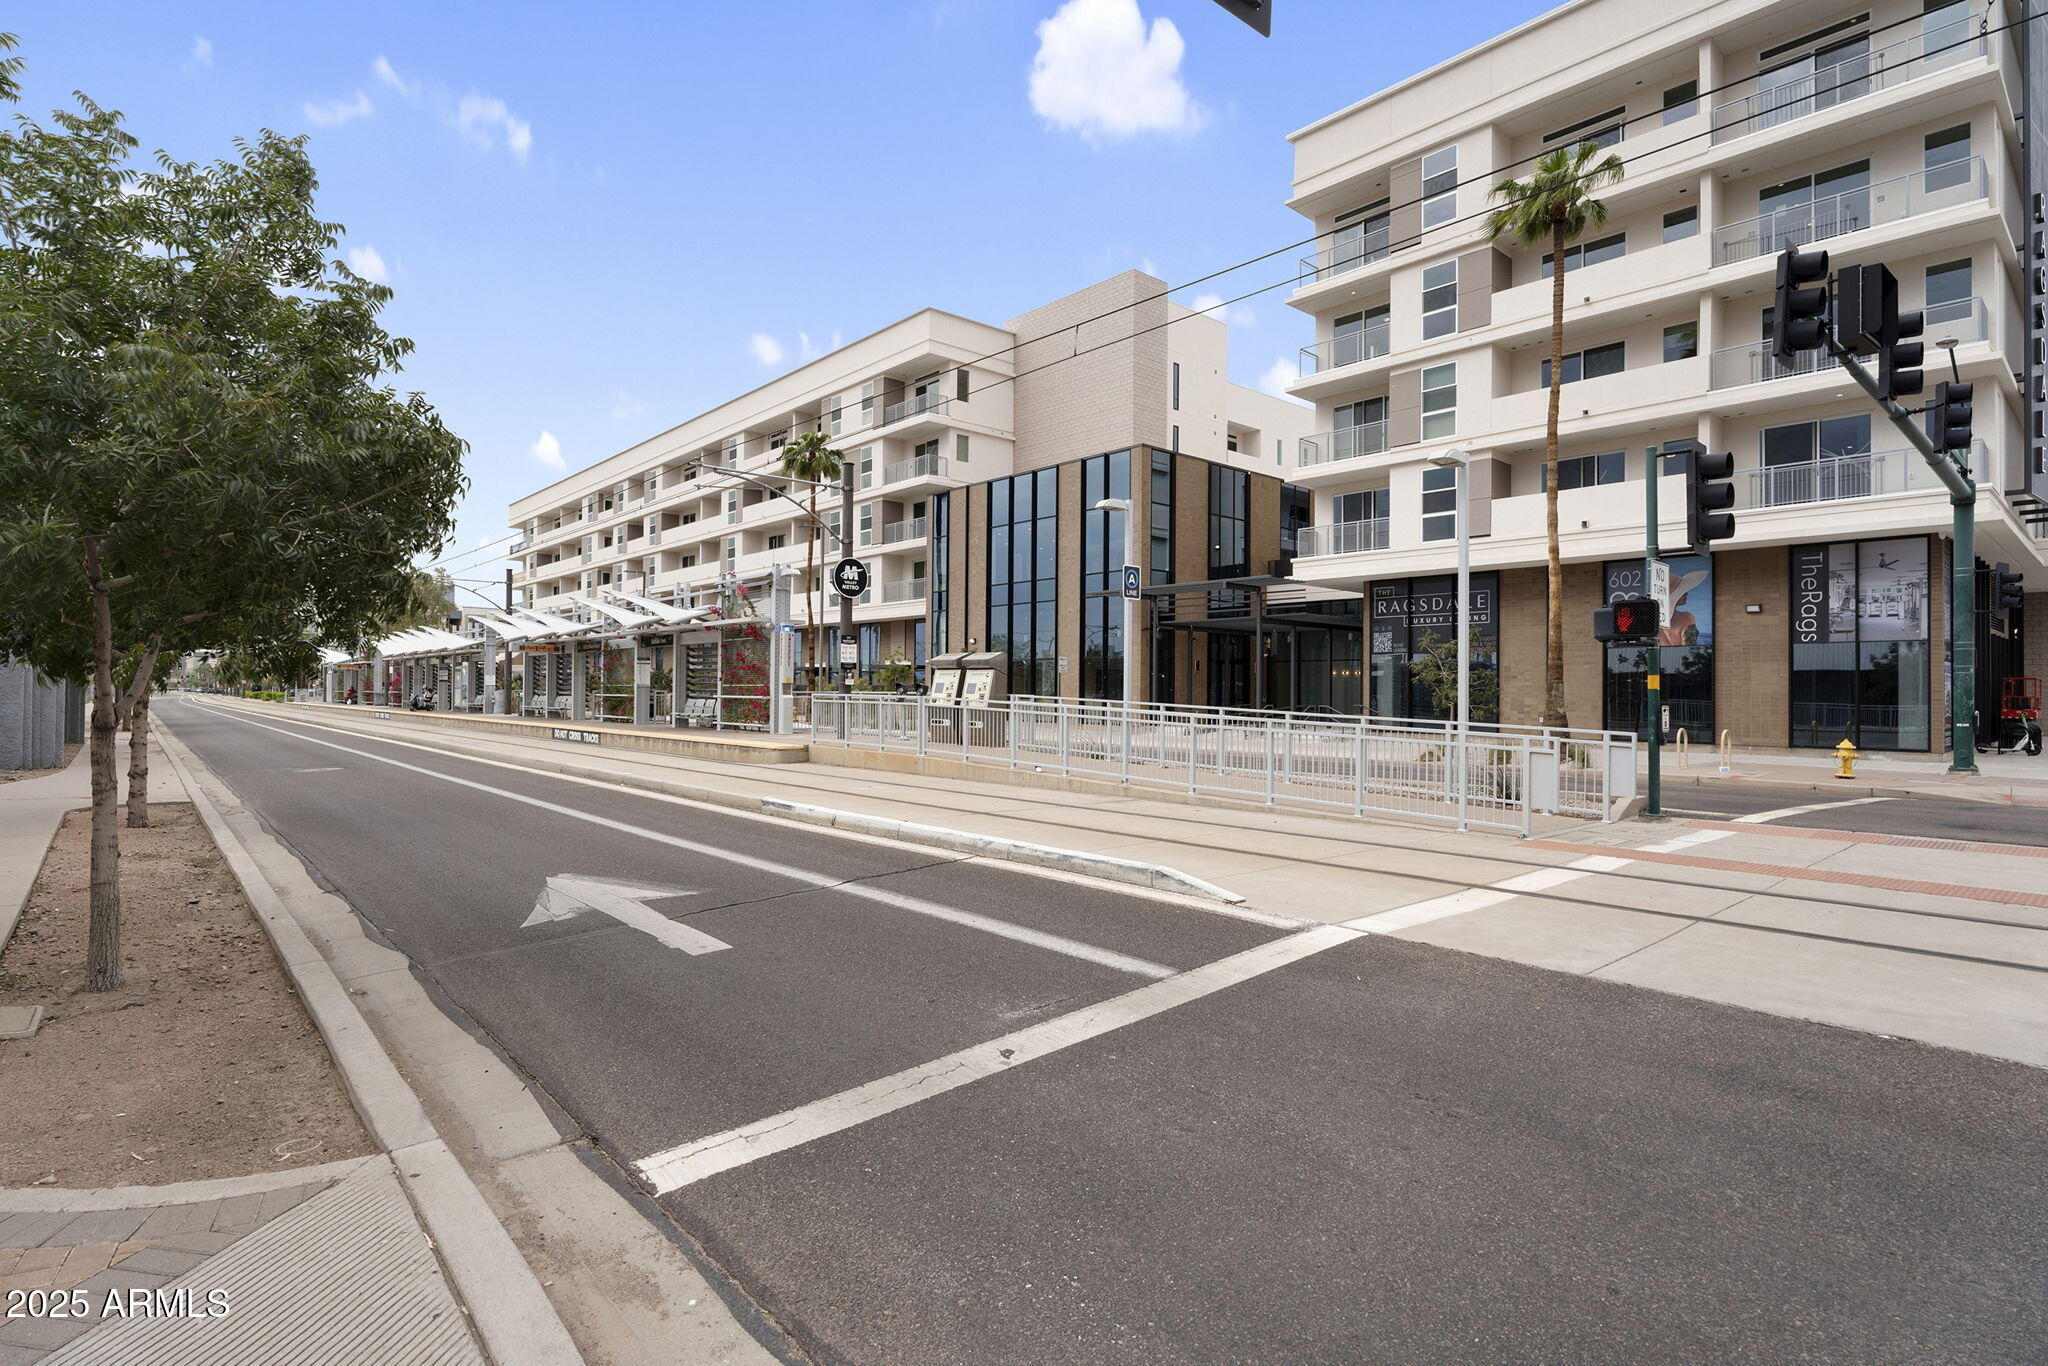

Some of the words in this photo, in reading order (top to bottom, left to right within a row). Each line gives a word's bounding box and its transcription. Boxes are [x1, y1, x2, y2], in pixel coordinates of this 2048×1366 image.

[1128, 573, 1136, 584] A
[1609, 570, 1641, 588] 602
[1656, 568, 1665, 582] NO
[1654, 583, 1667, 596] TURN
[1378, 594, 1486, 614] RAGSDAE
[1796, 552, 1823, 642] TheRags
[568, 731, 581, 741] CROSS
[583, 732, 600, 743] TRACKS
